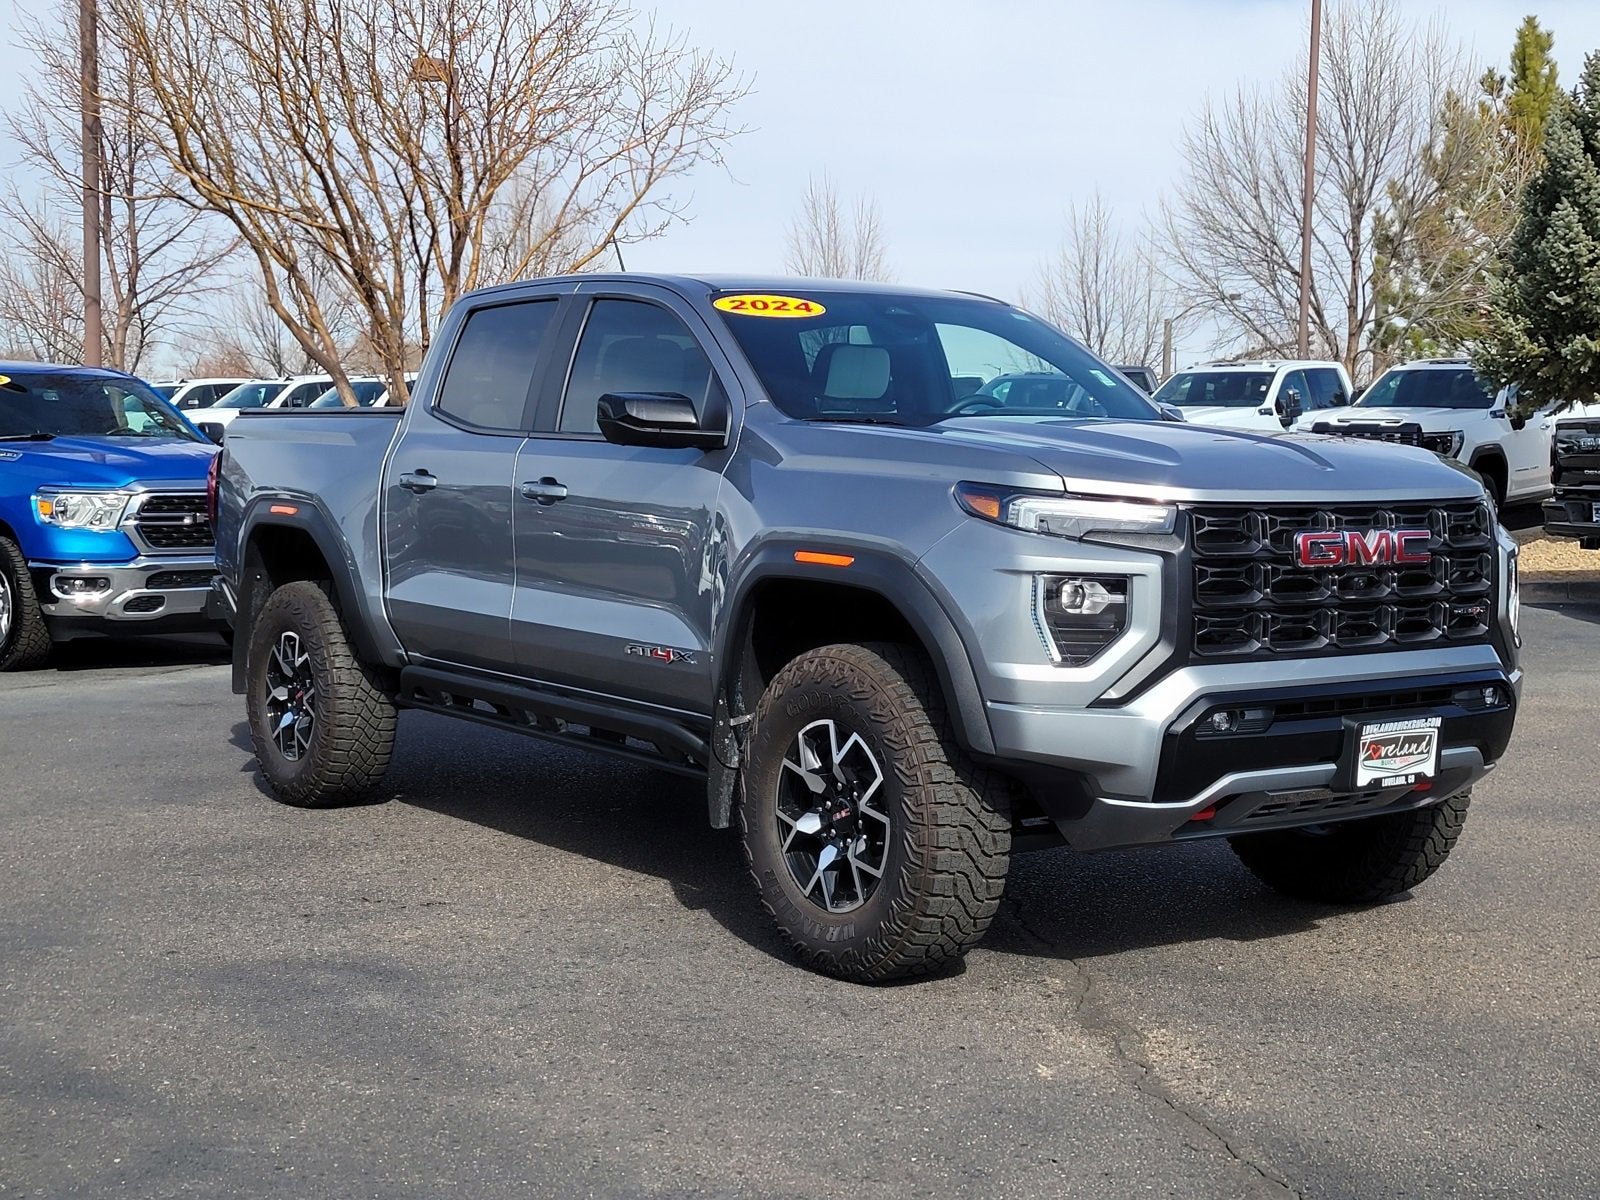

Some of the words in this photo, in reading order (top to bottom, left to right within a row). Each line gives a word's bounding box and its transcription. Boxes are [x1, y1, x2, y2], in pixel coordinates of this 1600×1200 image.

[729, 299, 814, 313] 2024
[1295, 529, 1431, 568] GMC
[624, 643, 697, 664] AT4X
[1381, 775, 1407, 787] LOVELAND,
